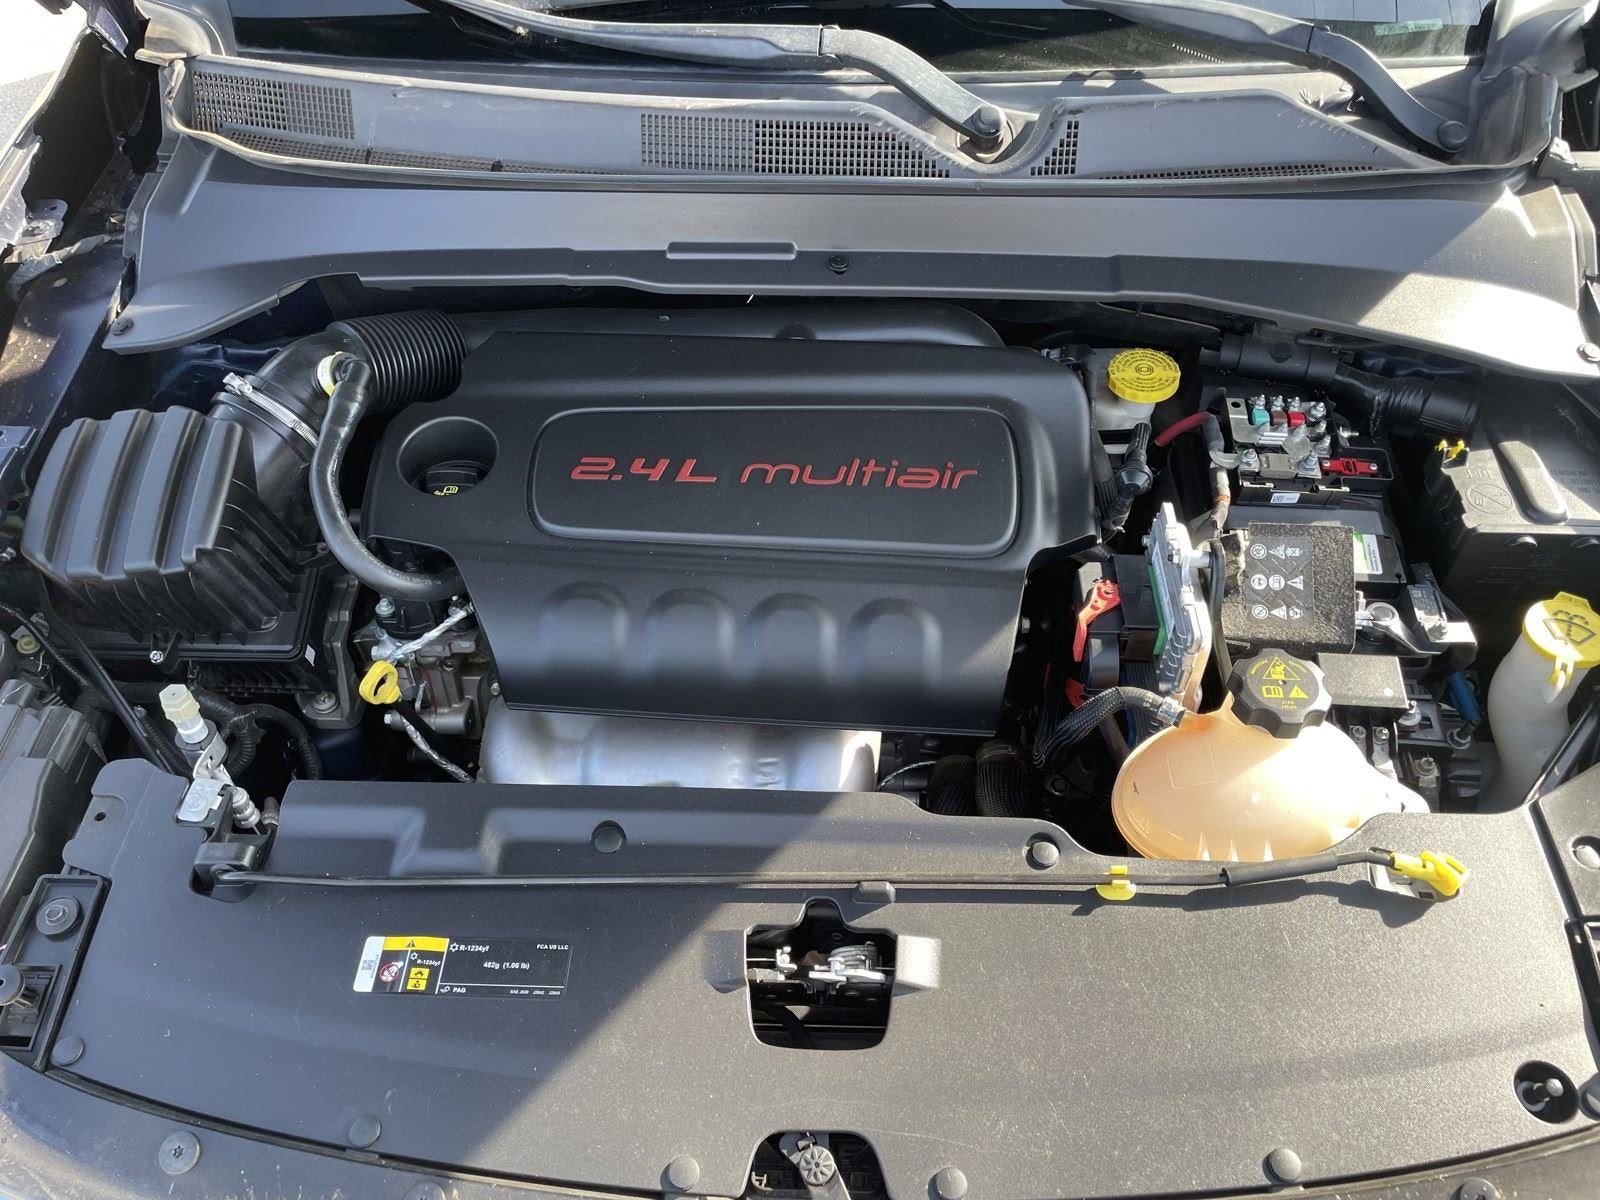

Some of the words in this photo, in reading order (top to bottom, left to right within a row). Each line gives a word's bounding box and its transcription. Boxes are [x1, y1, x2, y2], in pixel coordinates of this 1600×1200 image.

[739, 457, 979, 490] multiair
[459, 944, 490, 953] R-1234yf
[416, 958, 441, 967] R-1234yf
[483, 961, 500, 970] 482g
[520, 962, 530, 970] lb)
[452, 986, 466, 994] PAG
